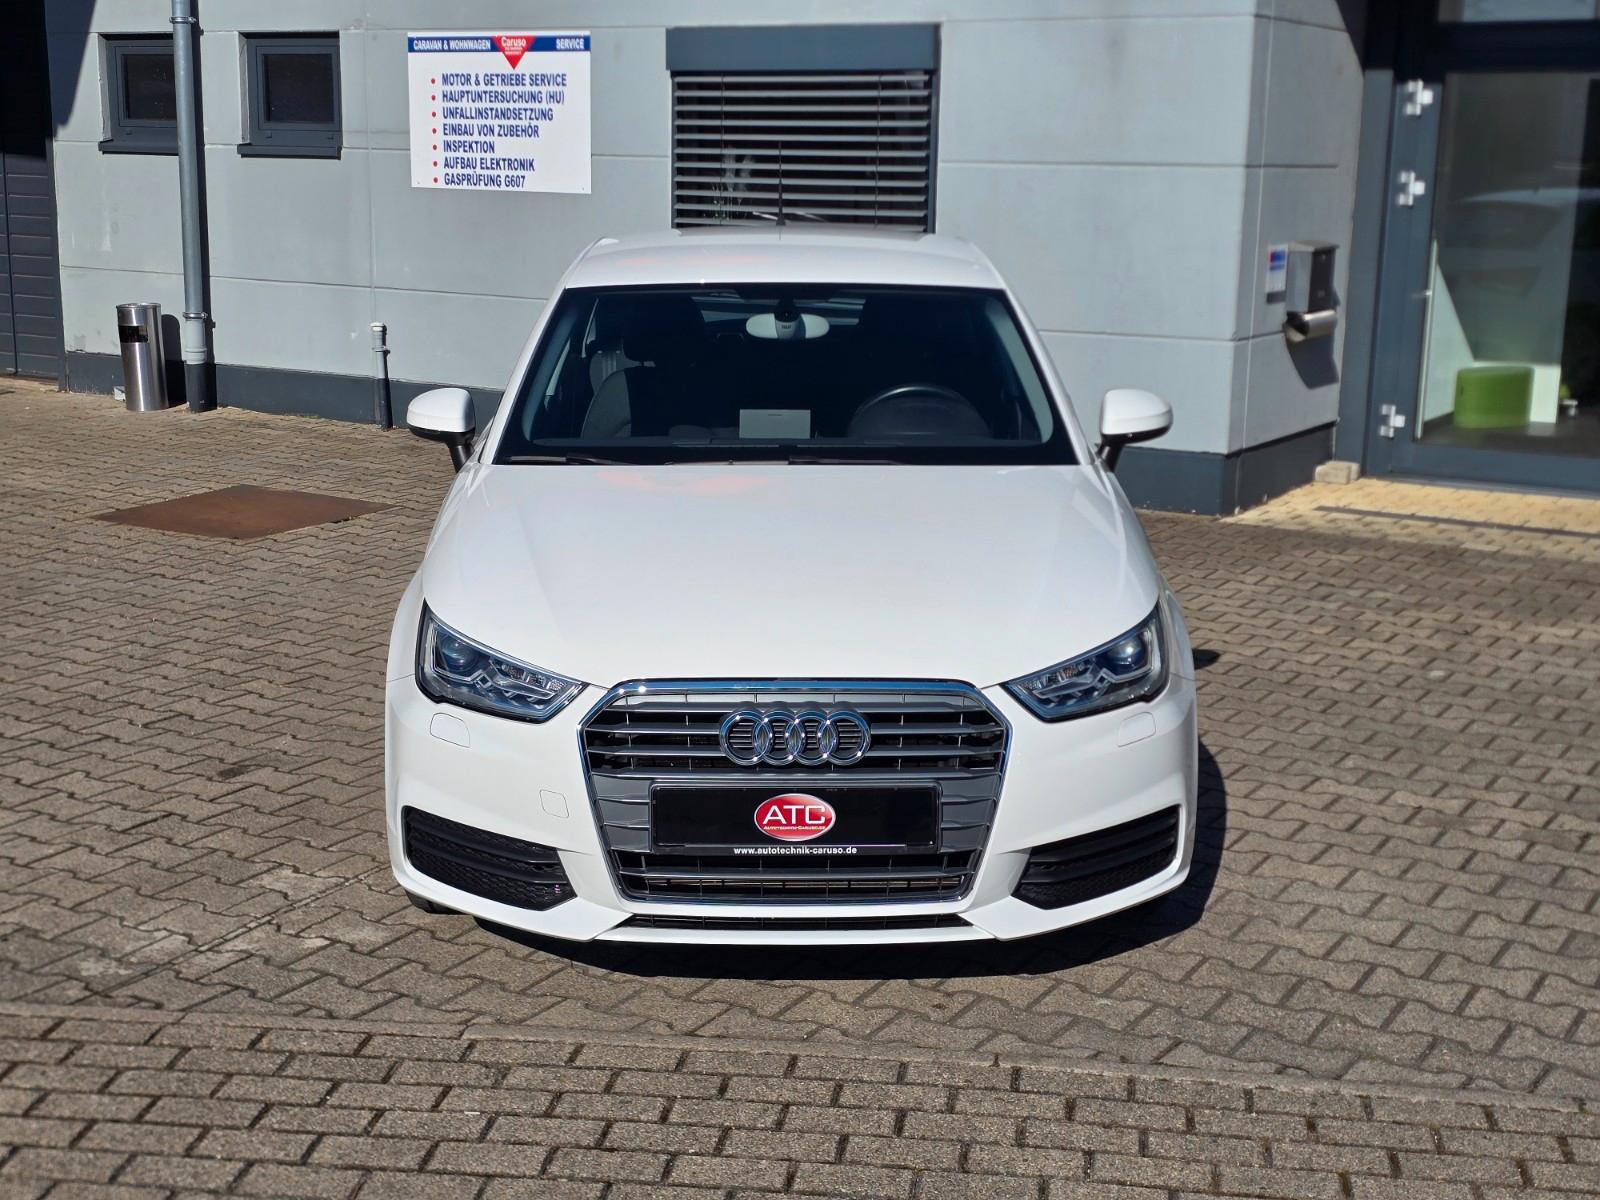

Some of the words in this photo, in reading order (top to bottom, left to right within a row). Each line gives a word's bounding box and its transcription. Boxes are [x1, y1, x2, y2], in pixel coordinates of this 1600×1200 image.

[413, 40, 442, 50] CARAVAN
[443, 40, 448, 50] &
[449, 40, 491, 50] WOHNWAGEN
[501, 36, 526, 48] Caruso
[556, 38, 584, 49] SERVICE
[442, 74, 471, 86] MOTOR
[475, 74, 480, 86] &
[483, 74, 525, 86] GETRIEBE
[529, 74, 567, 87] SERVICE
[442, 90, 543, 104] HAUPTUNTERSUCHUNG
[545, 91, 565, 105] (HU)
[443, 107, 554, 122] UNFALLINSTANDSETZUNG
[443, 123, 474, 136] EINBAU
[477, 124, 495, 137] VON
[497, 122, 540, 138] ZUBEHÖR
[443, 140, 495, 154] INSPEKTION
[444, 156, 477, 170] AUFBAU
[480, 157, 535, 172] ELEKTRONIK
[444, 171, 502, 188] GASPRÜFUNG
[504, 174, 526, 188] G607
[762, 805, 825, 825] ATC
[733, 846, 858, 855] www.autotechnik-caruso.de
